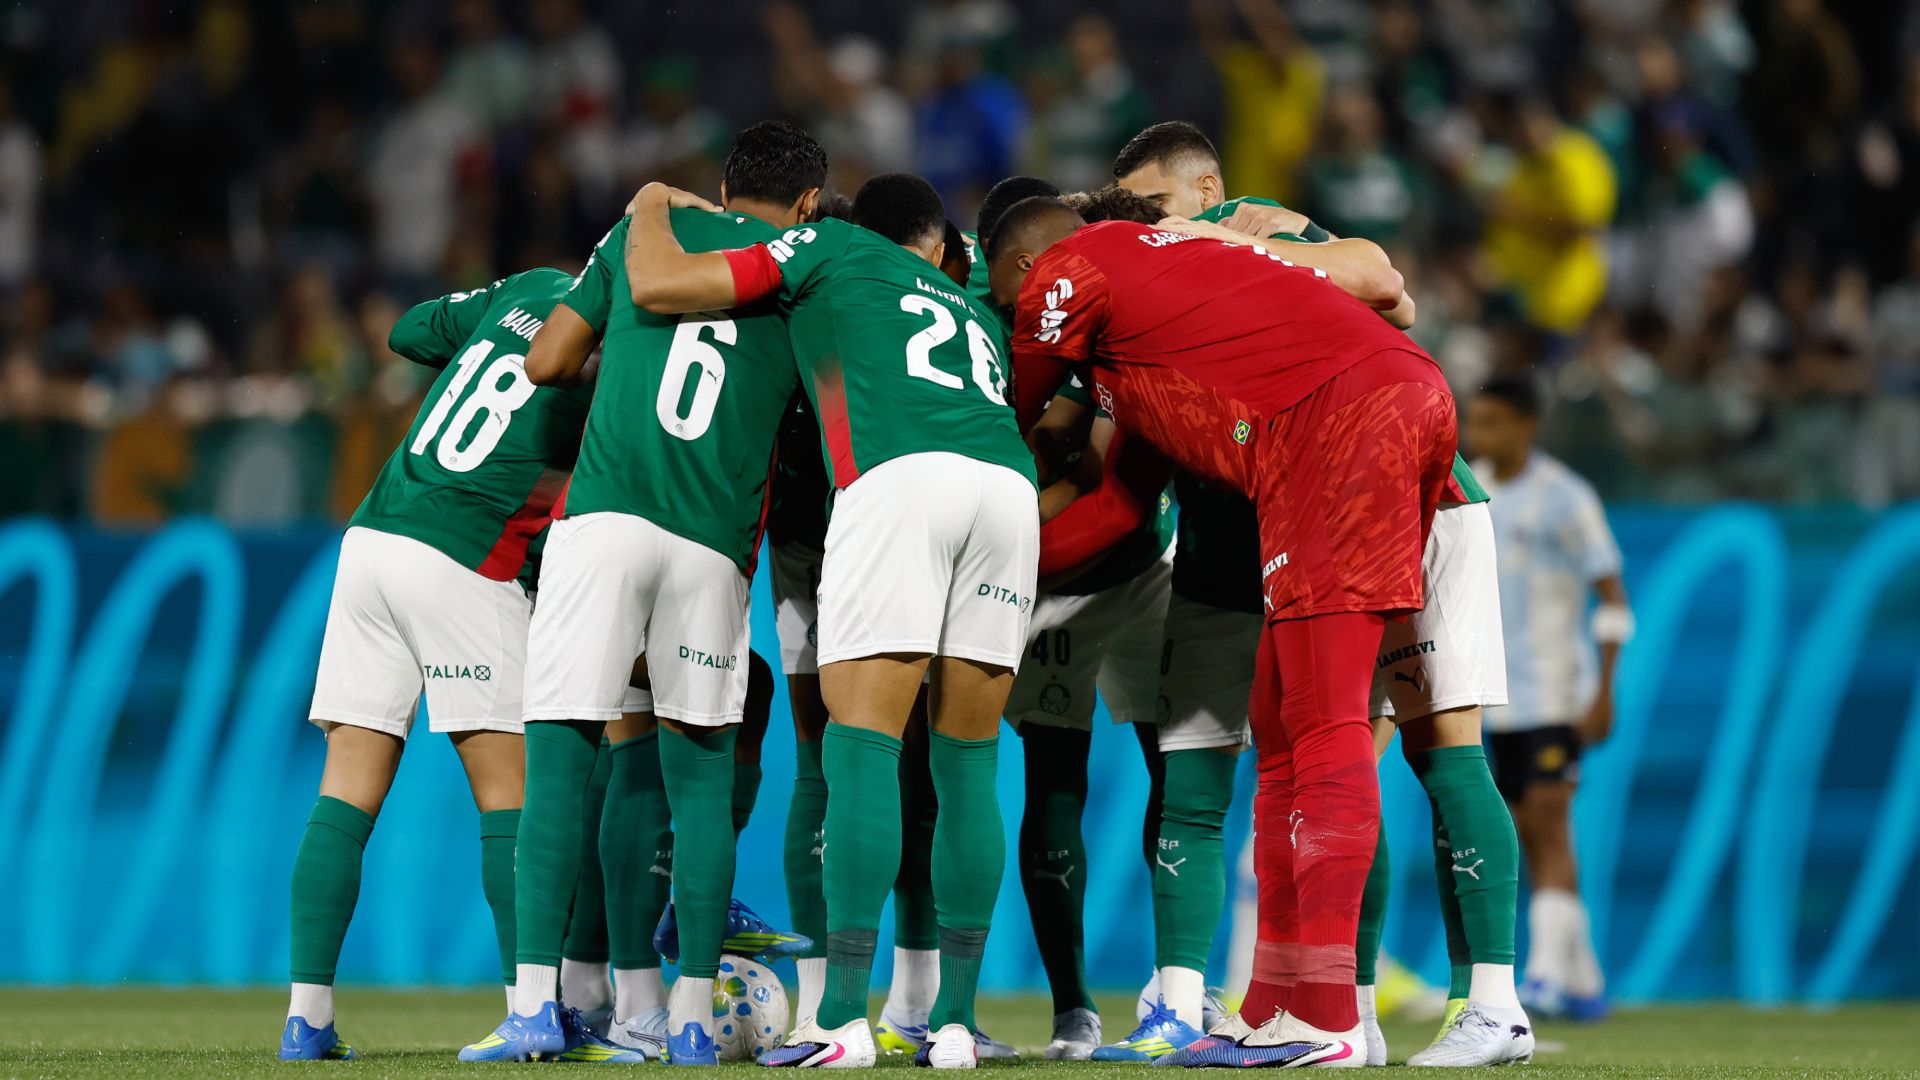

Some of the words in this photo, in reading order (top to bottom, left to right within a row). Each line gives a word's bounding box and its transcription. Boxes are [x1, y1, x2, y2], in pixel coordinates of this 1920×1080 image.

[656, 311, 738, 441] 6
[410, 339, 537, 472] 18
[1262, 552, 1288, 584] SELVI
[1031, 628, 1071, 667] 40
[1158, 837, 1179, 850] SEP
[1451, 847, 1476, 859] SEP
